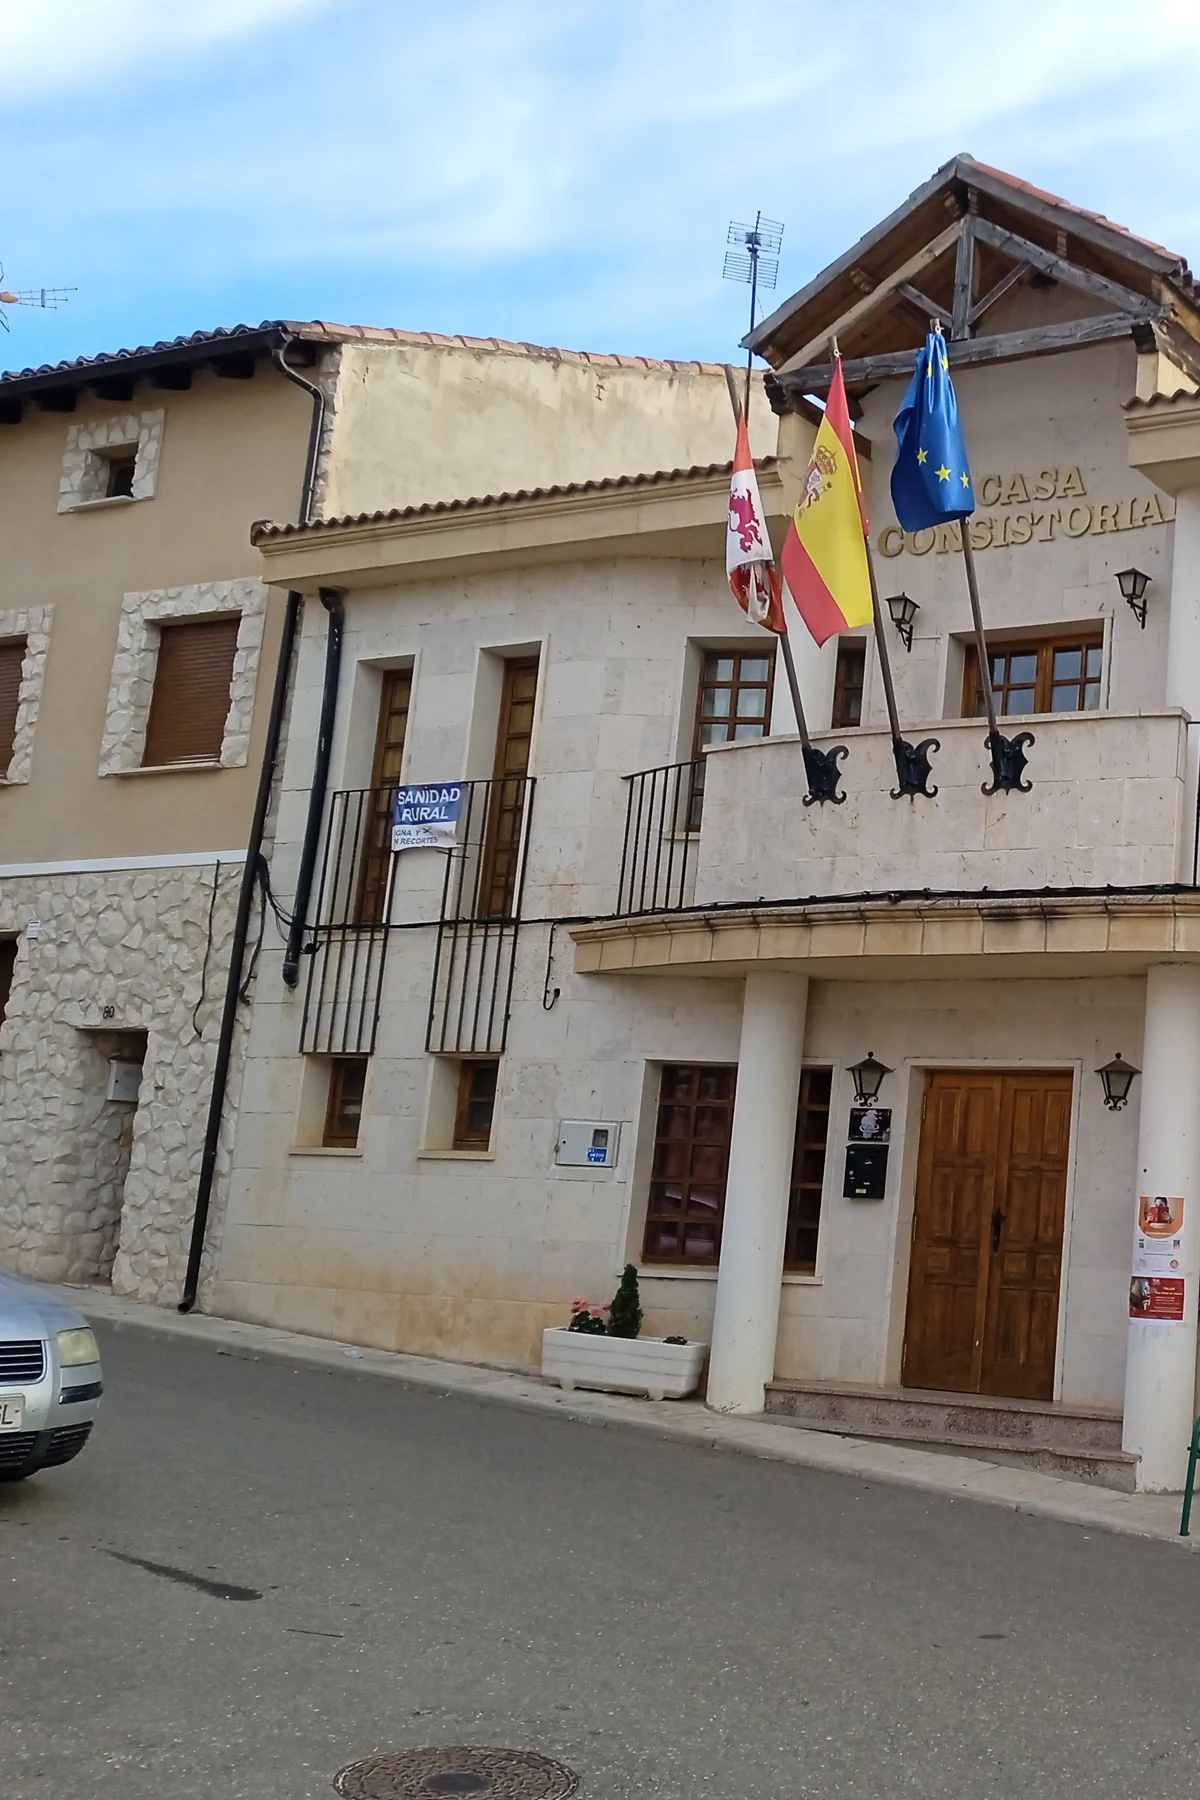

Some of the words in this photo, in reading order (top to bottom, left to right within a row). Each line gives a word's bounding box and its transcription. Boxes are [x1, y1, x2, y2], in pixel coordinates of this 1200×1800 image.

[979, 465, 1087, 507] CASA
[397, 788, 460, 805] SANIDAD
[401, 806, 449, 822] RURAL
[395, 829, 412, 837] GNA
[400, 836, 438, 845] RECORTES
[102, 1005, 115, 1019] 80
[0, 1404, 14, 1425] L
